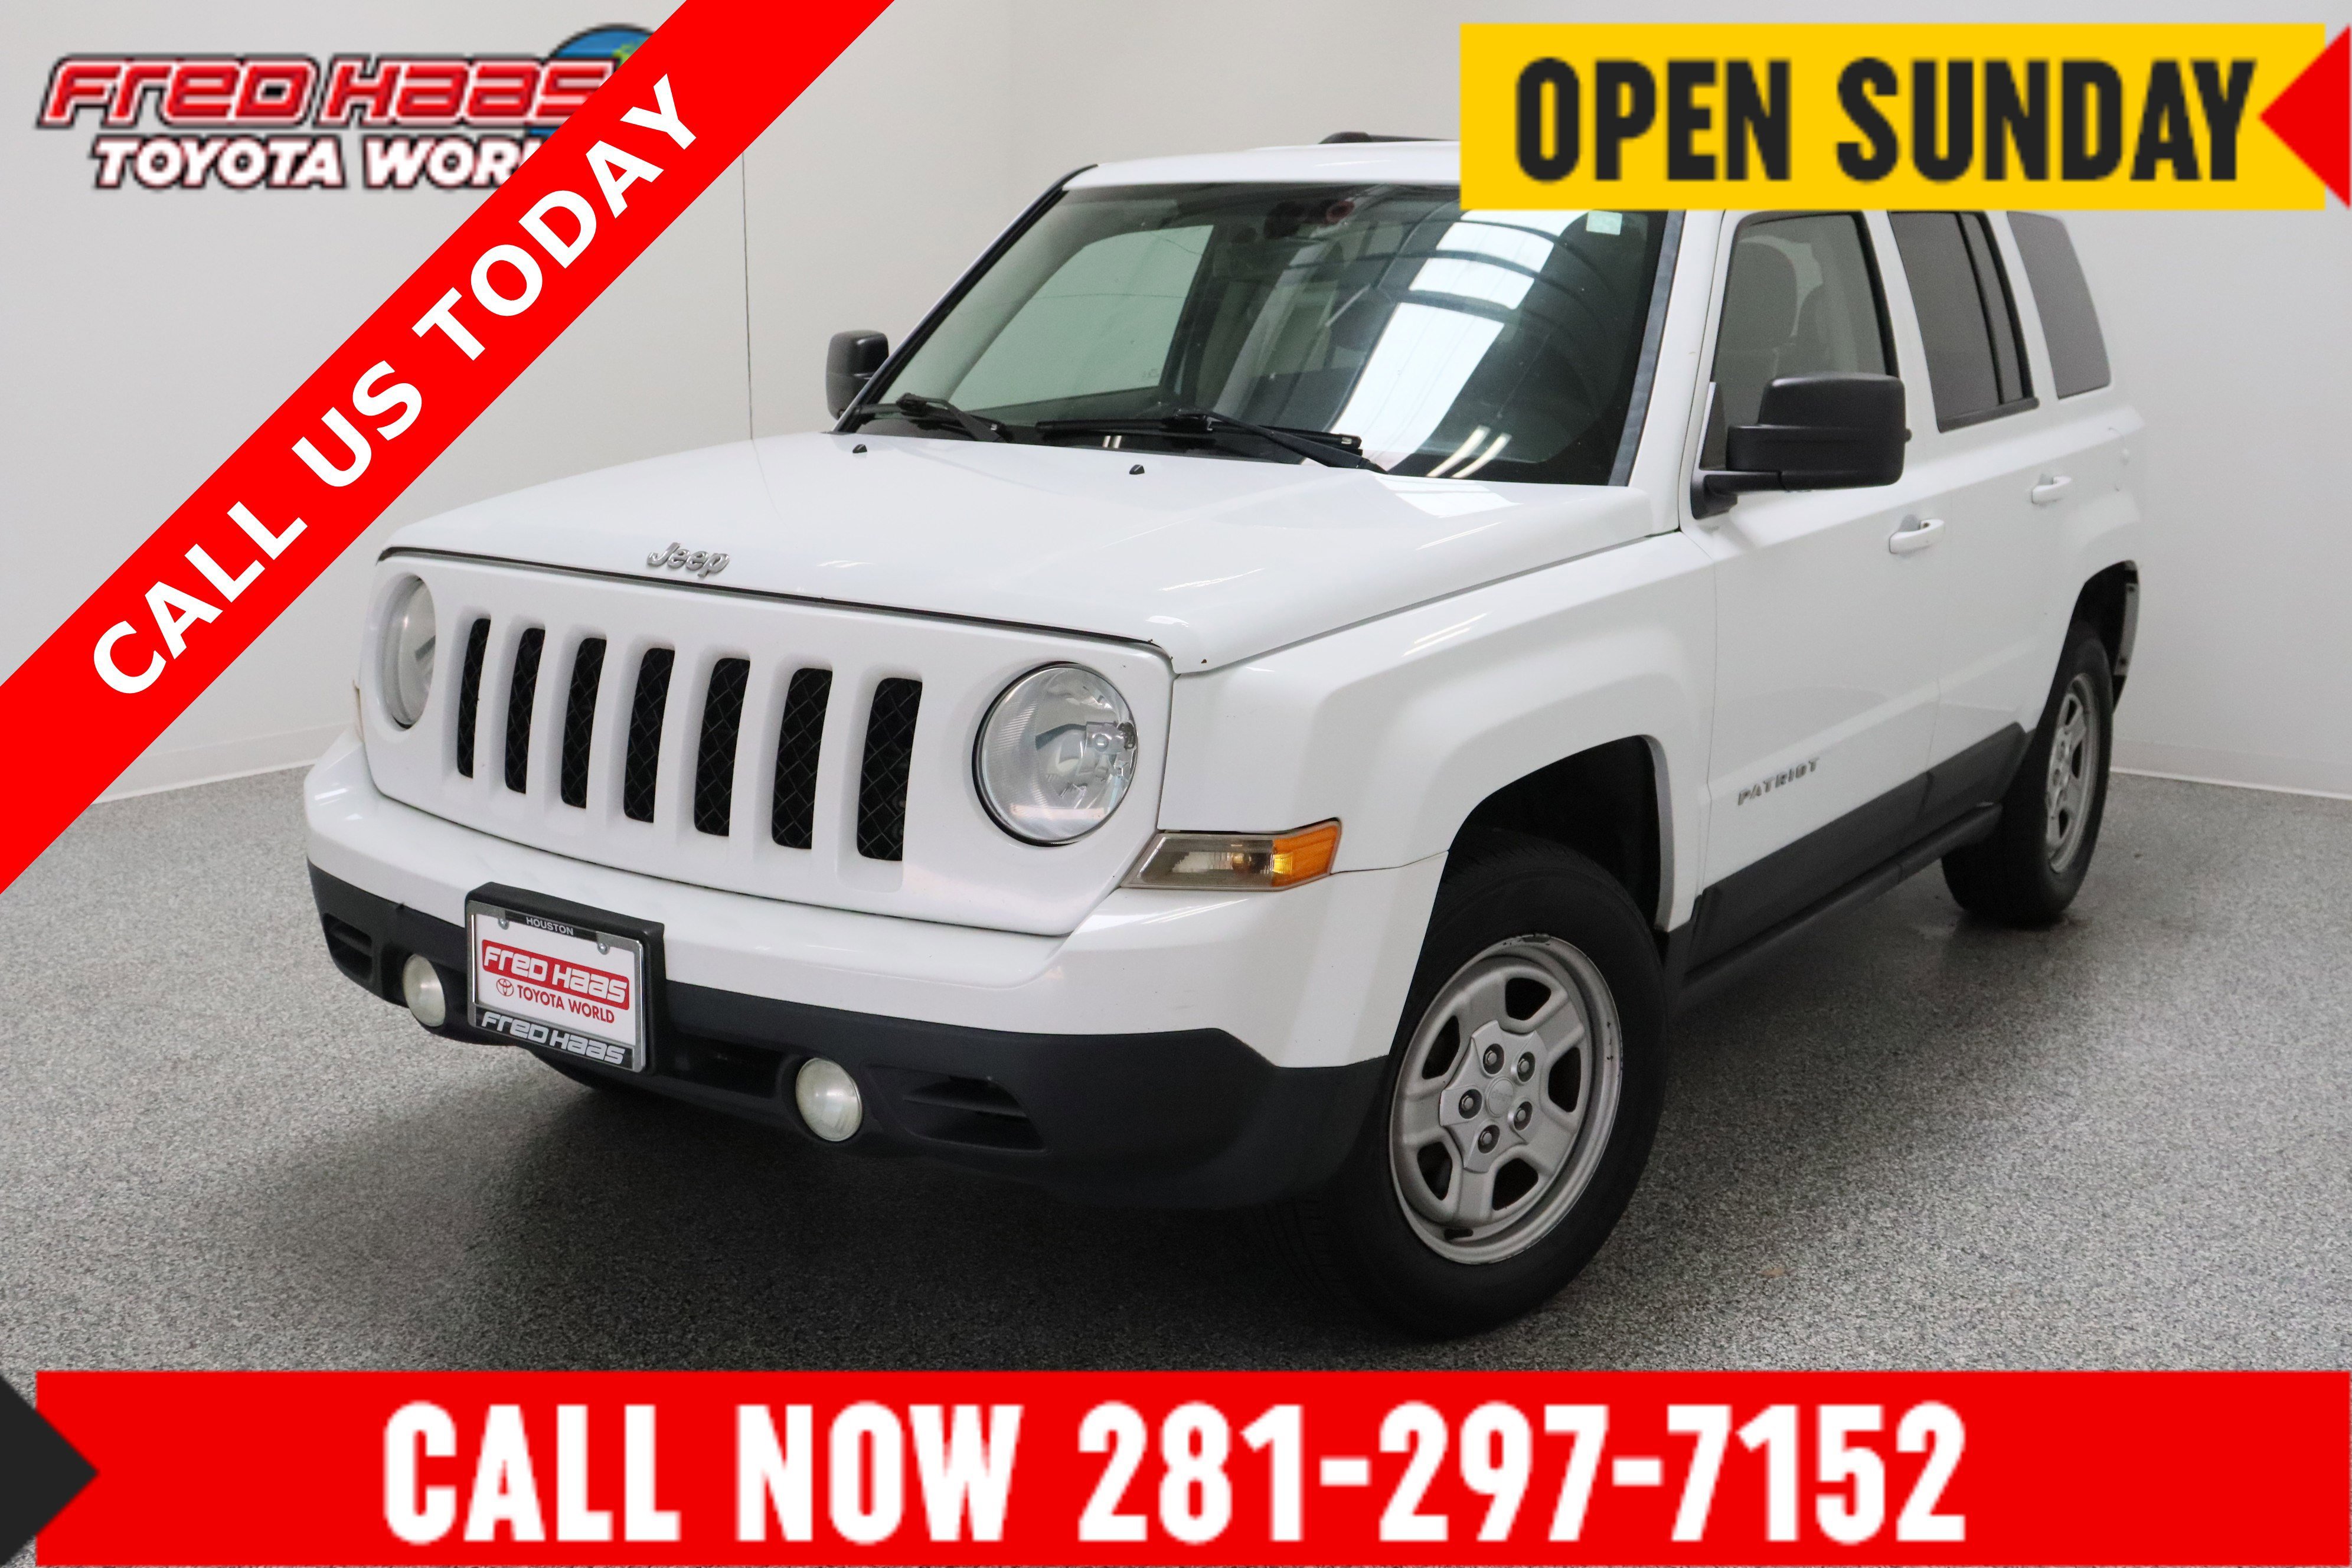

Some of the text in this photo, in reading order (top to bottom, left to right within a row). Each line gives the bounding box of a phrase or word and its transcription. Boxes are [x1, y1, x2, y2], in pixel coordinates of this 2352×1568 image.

[647, 542, 730, 577] Jeep
[1737, 757, 1819, 806] PATRIOT
[525, 917, 574, 936] HOUSTON
[517, 985, 615, 1024] TOYOTA WORLD
